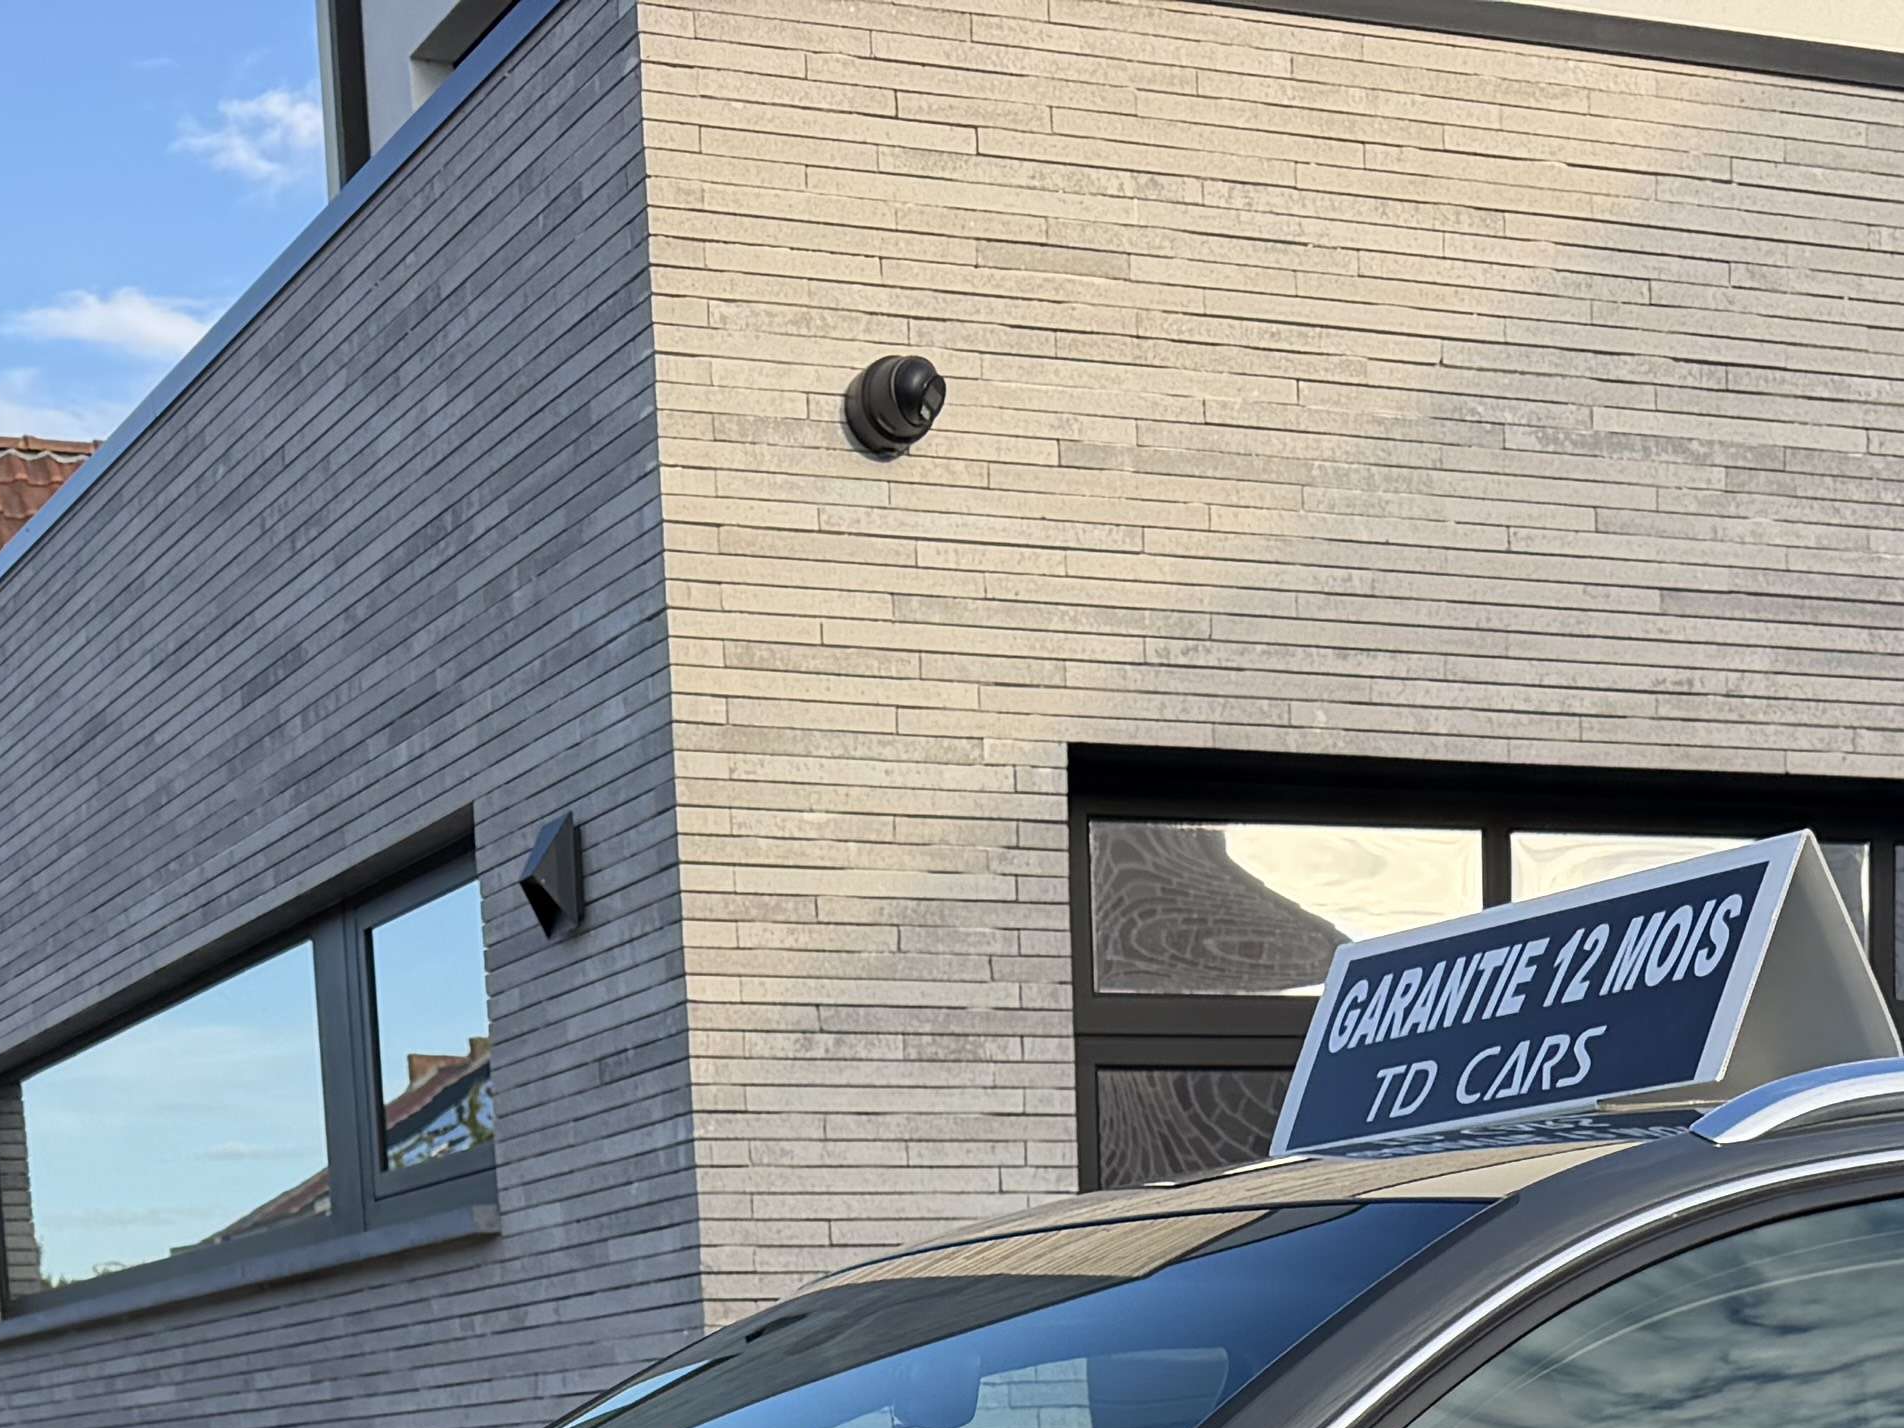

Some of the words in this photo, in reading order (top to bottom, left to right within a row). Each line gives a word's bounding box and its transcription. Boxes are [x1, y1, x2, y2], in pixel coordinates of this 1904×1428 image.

[1328, 936, 1550, 1054] GARANTIE
[1542, 923, 1610, 1008] 12
[1598, 893, 1744, 997] MOIS
[1366, 1059, 1439, 1123] TD
[1455, 1024, 1608, 1105] CARS
